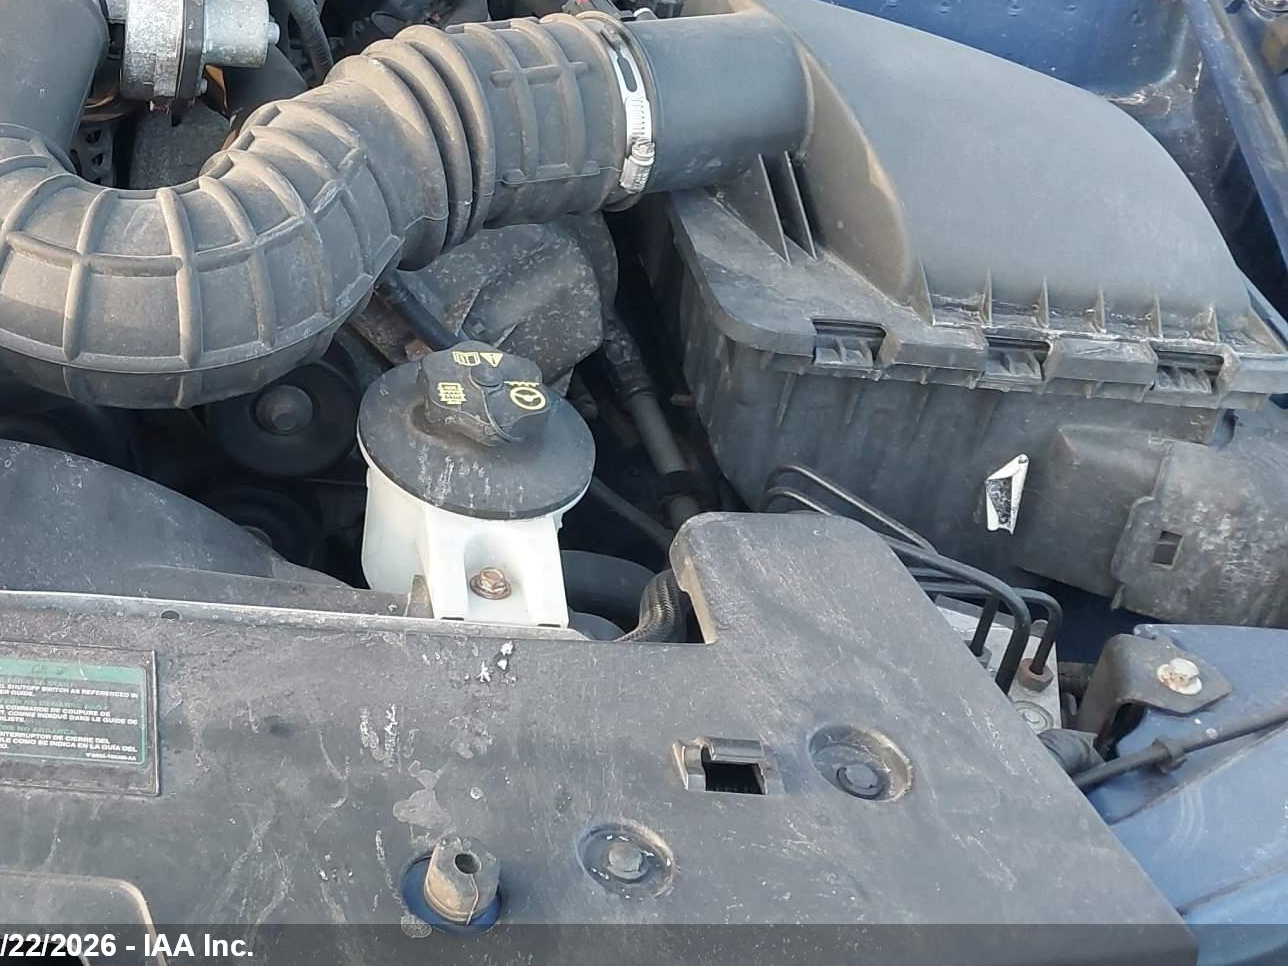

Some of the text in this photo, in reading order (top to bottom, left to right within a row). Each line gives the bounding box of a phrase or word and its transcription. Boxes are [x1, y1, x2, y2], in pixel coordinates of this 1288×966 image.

[81, 689, 129, 698] REFERENCED
[62, 708, 98, 716] COUPURE
[13, 737, 36, 745] COMO
[49, 740, 76, 748] INDICA
